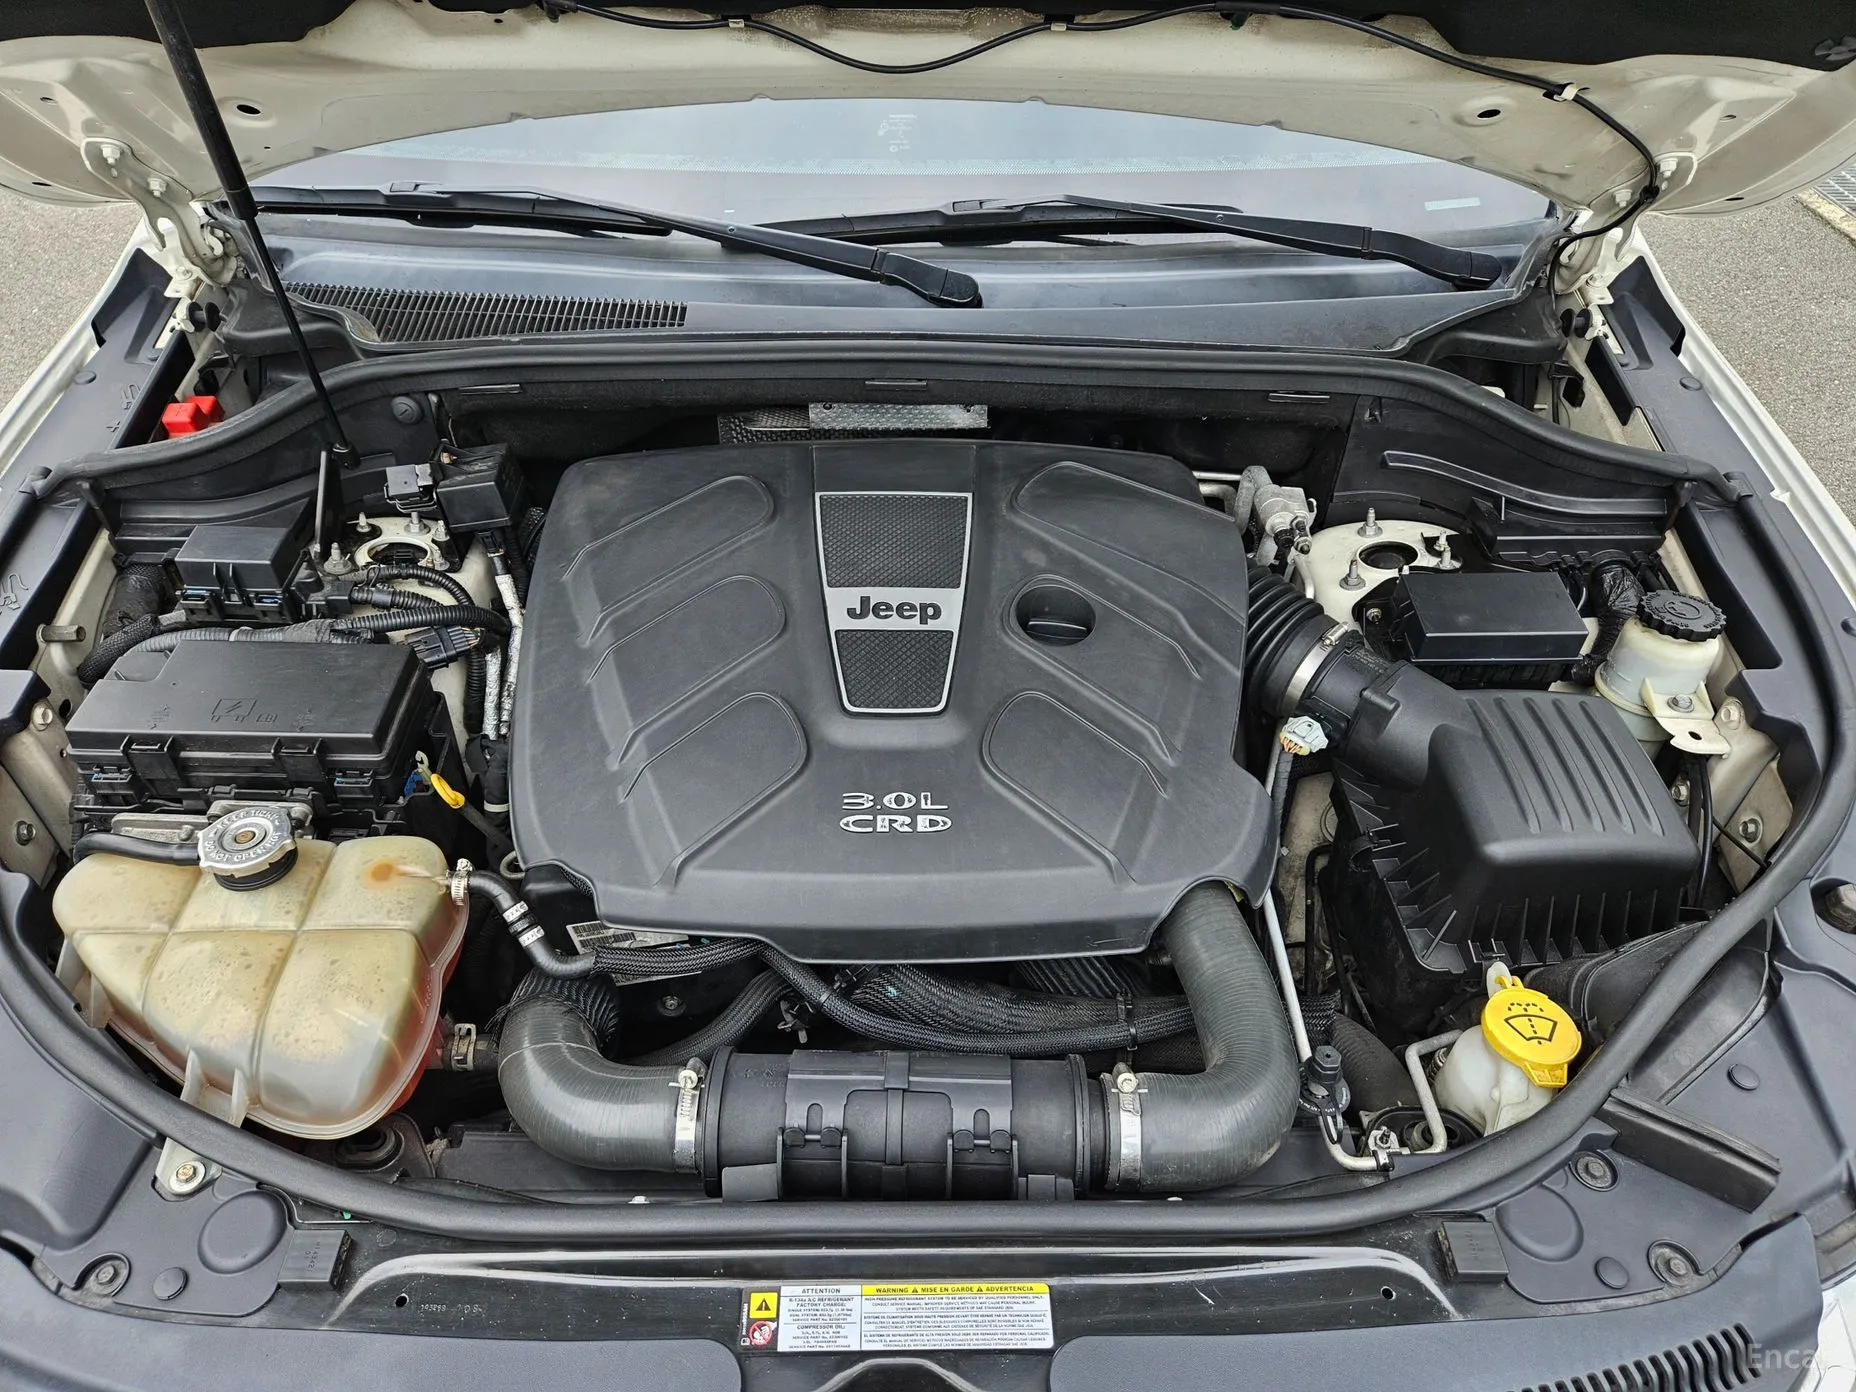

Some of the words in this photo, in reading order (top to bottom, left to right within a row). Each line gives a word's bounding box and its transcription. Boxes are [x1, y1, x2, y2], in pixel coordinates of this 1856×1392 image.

[847, 596, 942, 625] Jeep
[842, 792, 949, 811] 3.0L
[839, 814, 952, 833] CRD
